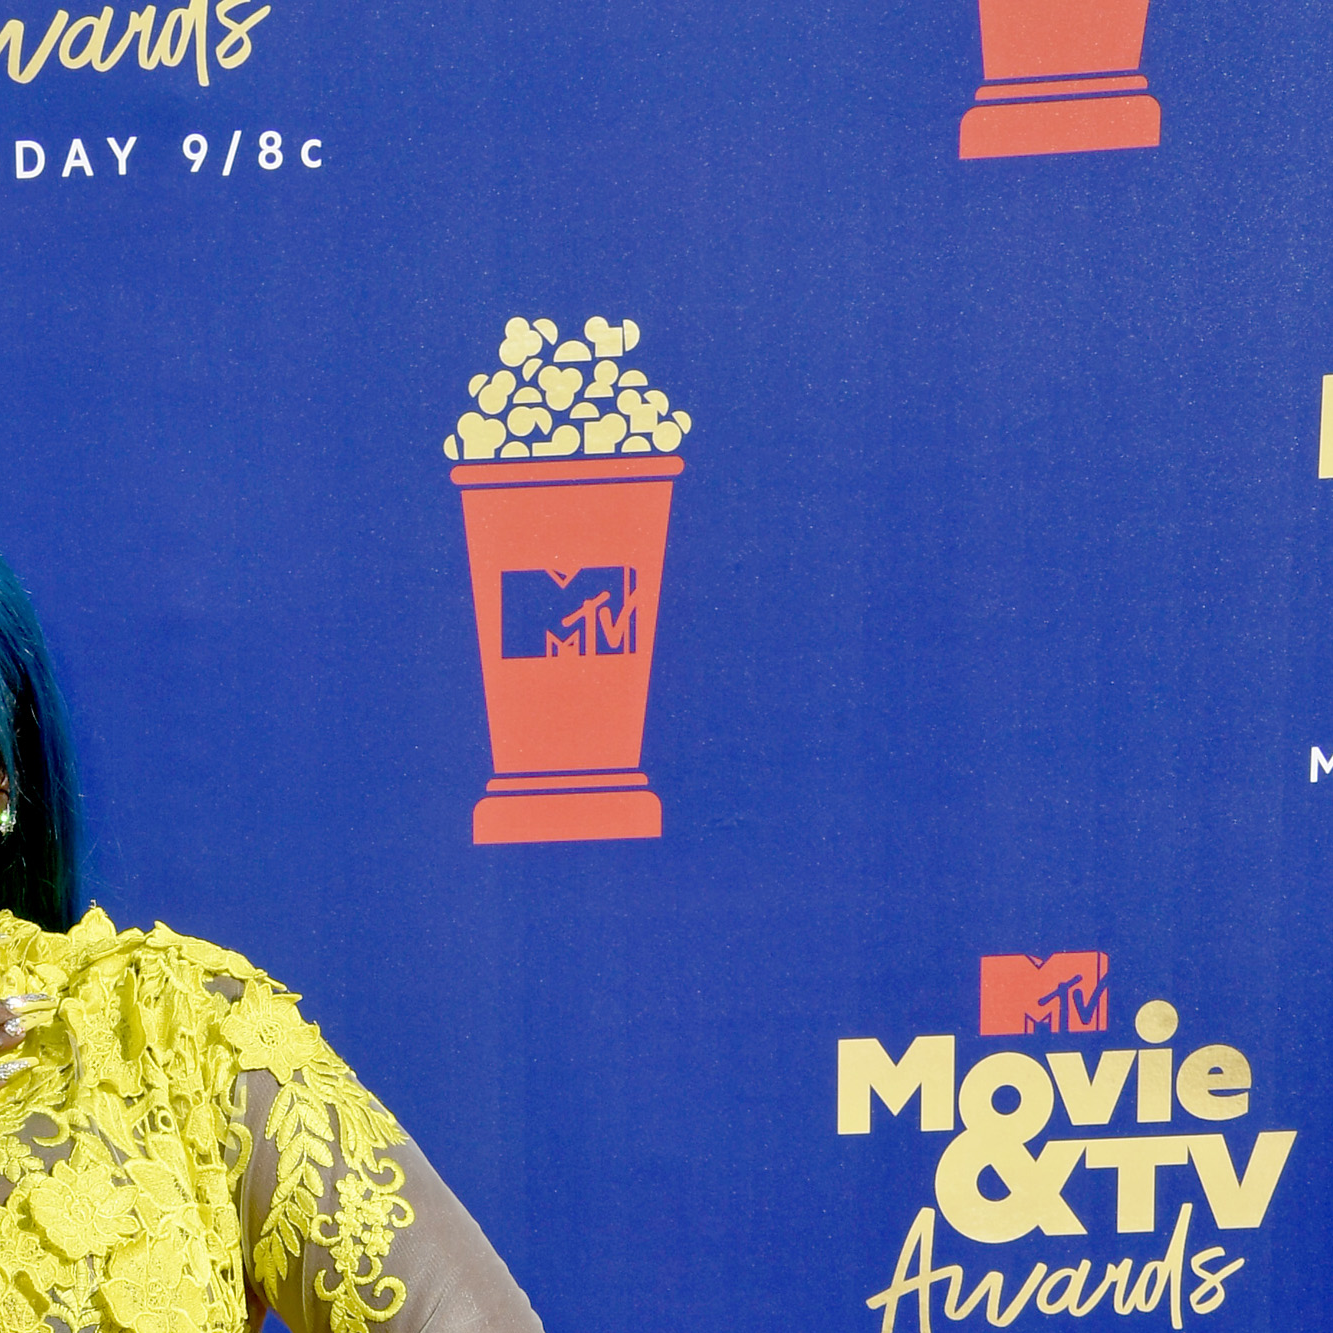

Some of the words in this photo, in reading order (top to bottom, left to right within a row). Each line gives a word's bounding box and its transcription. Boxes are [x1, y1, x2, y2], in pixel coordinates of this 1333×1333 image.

[182, 130, 323, 177] 9/8c
[501, 566, 637, 660] MTV
[979, 951, 1109, 1036] MTV
[837, 1000, 1252, 1135] Movie
